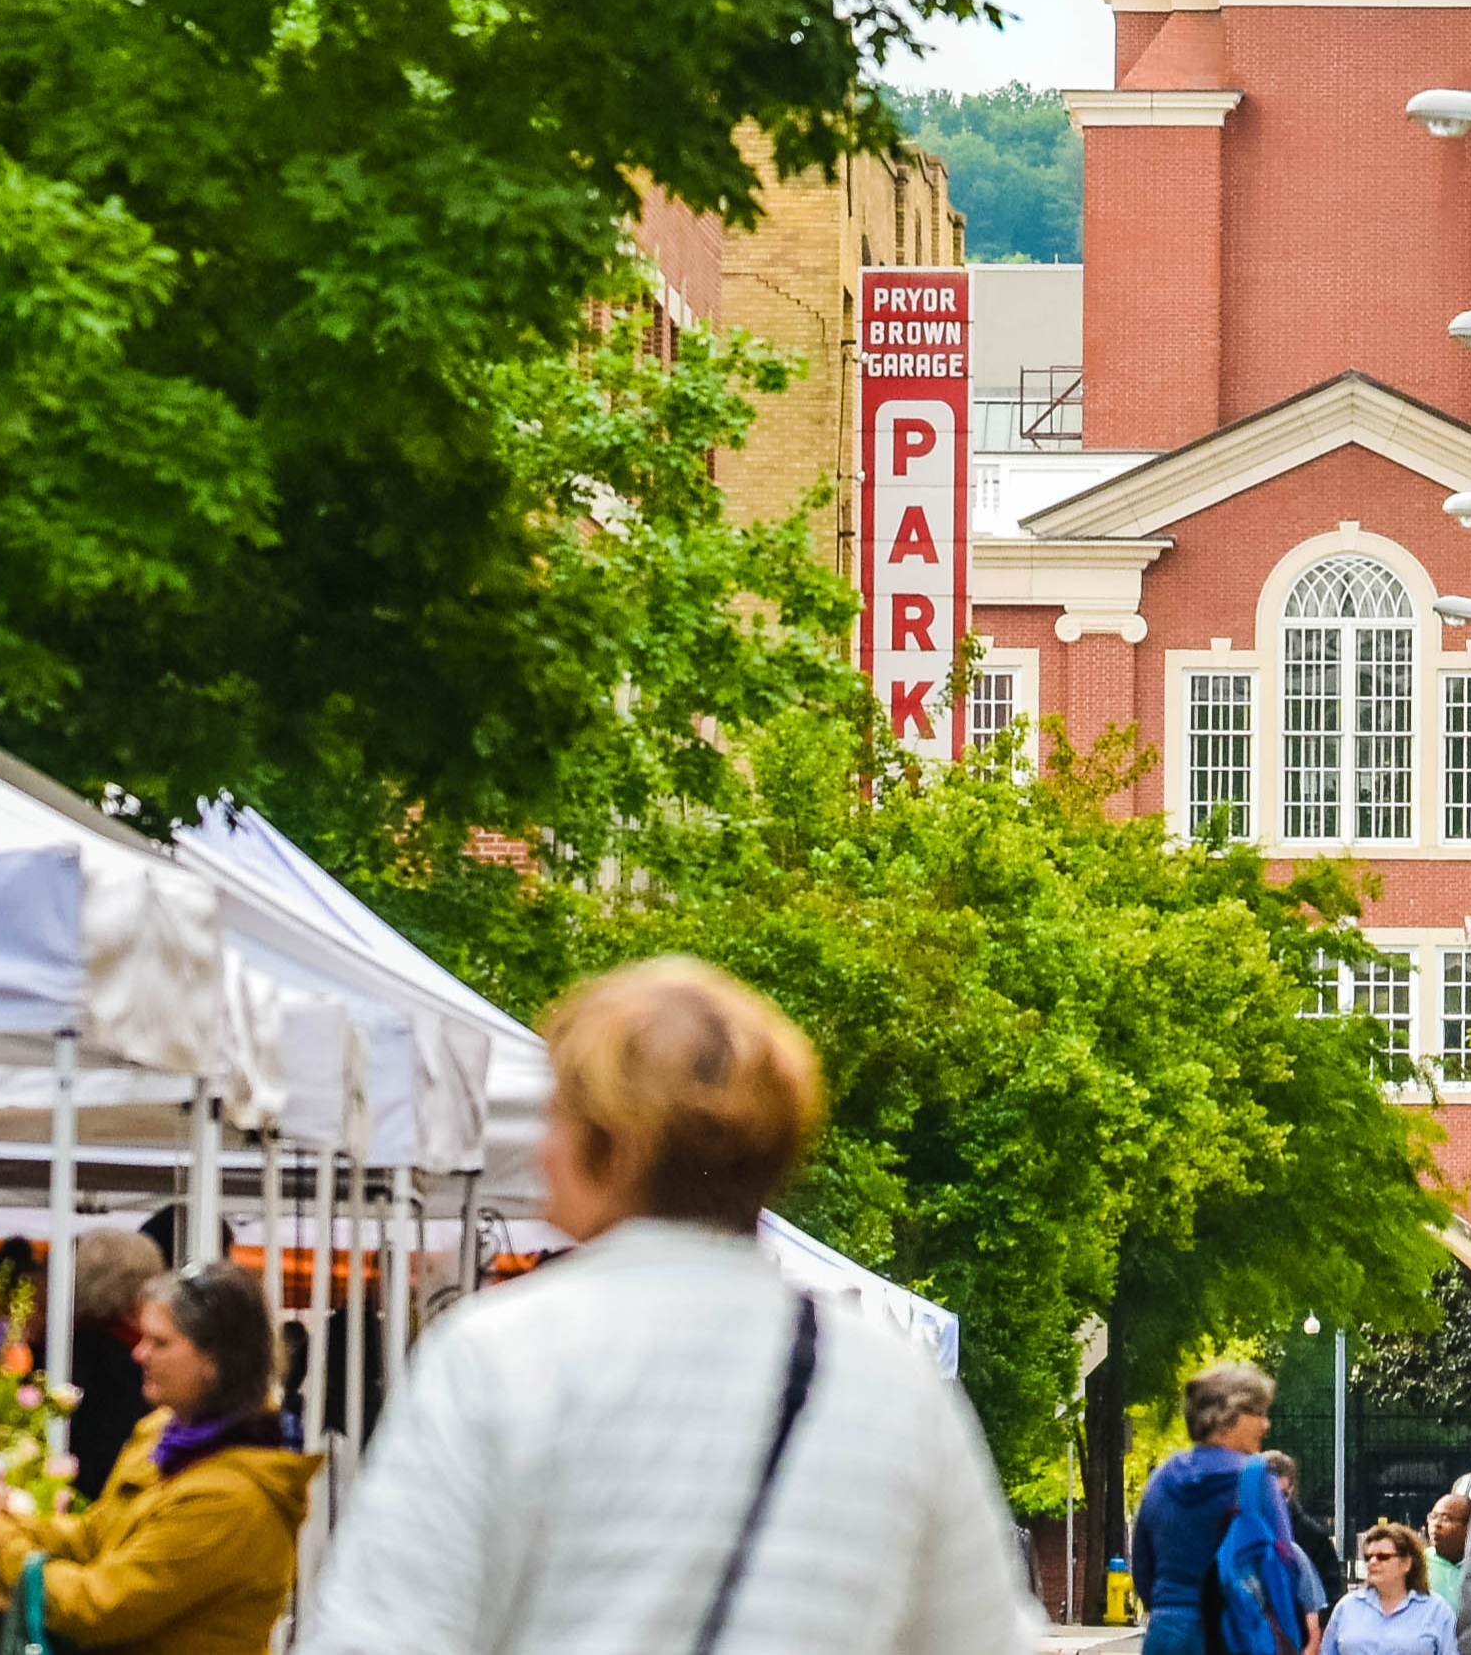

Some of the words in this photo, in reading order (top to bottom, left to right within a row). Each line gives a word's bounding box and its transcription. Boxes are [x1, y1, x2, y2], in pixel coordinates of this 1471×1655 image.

[873, 286, 957, 313] PRYOR
[870, 320, 962, 346] BROWN
[867, 352, 964, 378] GARAGE
[888, 418, 940, 740] PARK
